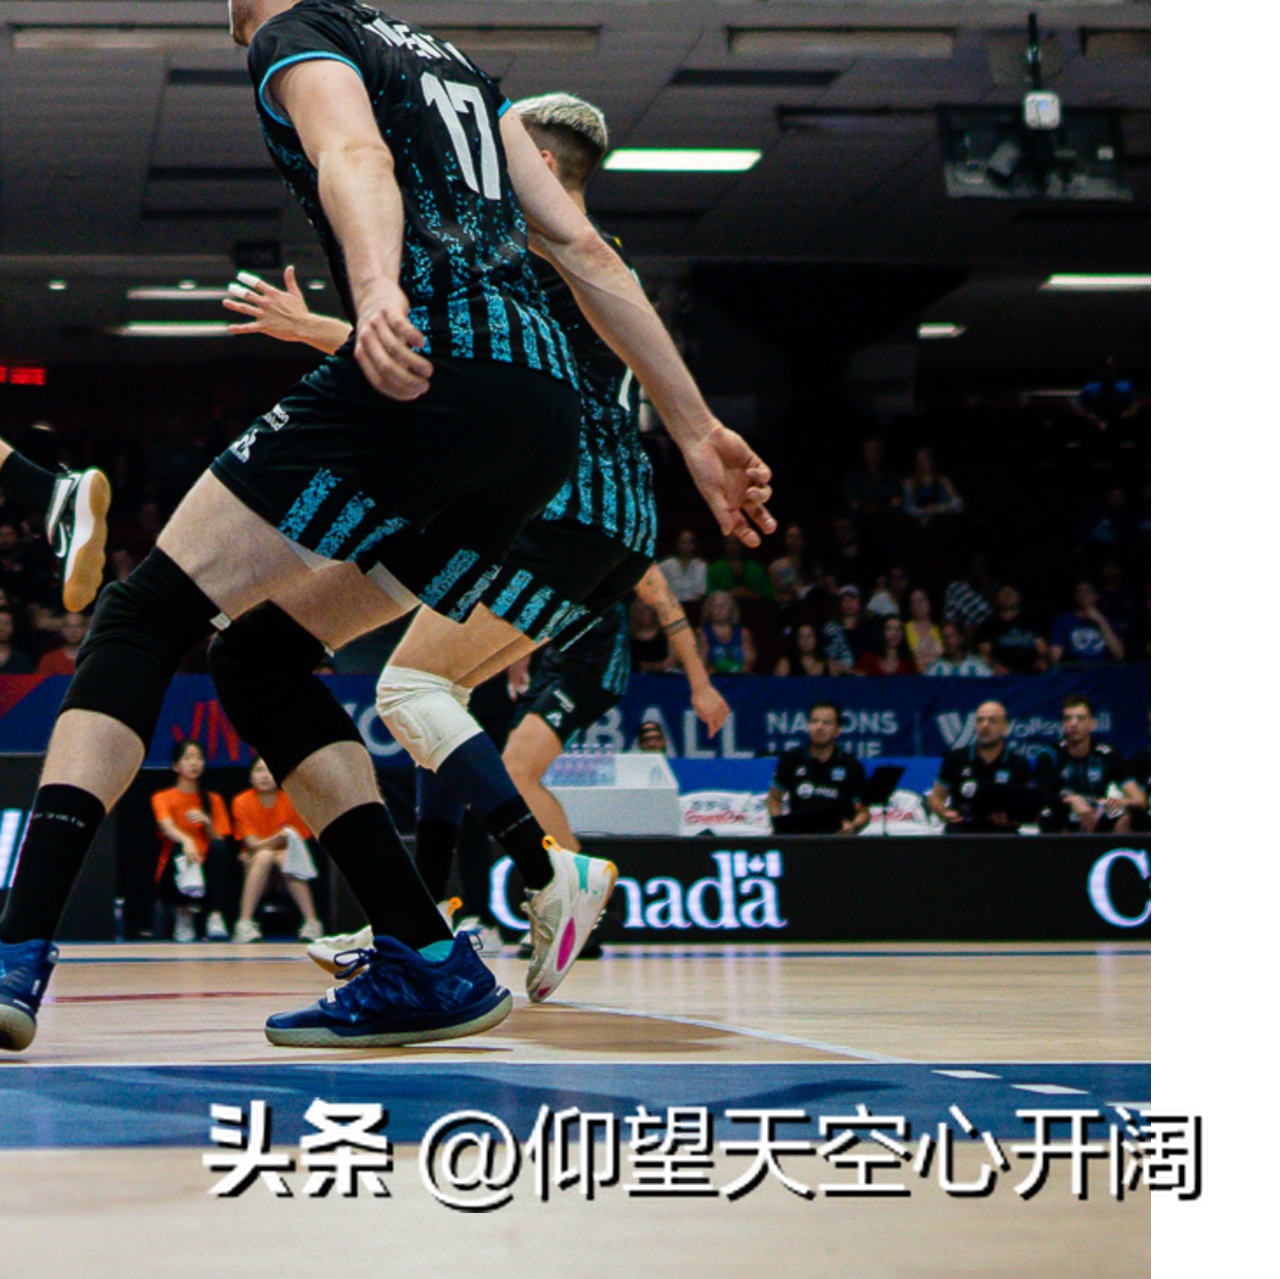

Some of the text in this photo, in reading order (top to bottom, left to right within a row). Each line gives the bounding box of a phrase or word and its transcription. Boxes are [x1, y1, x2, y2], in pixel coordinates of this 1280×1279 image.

[419, 71, 502, 201] 17
[766, 711, 898, 735] NAONS
[488, 850, 789, 930] Cnada
